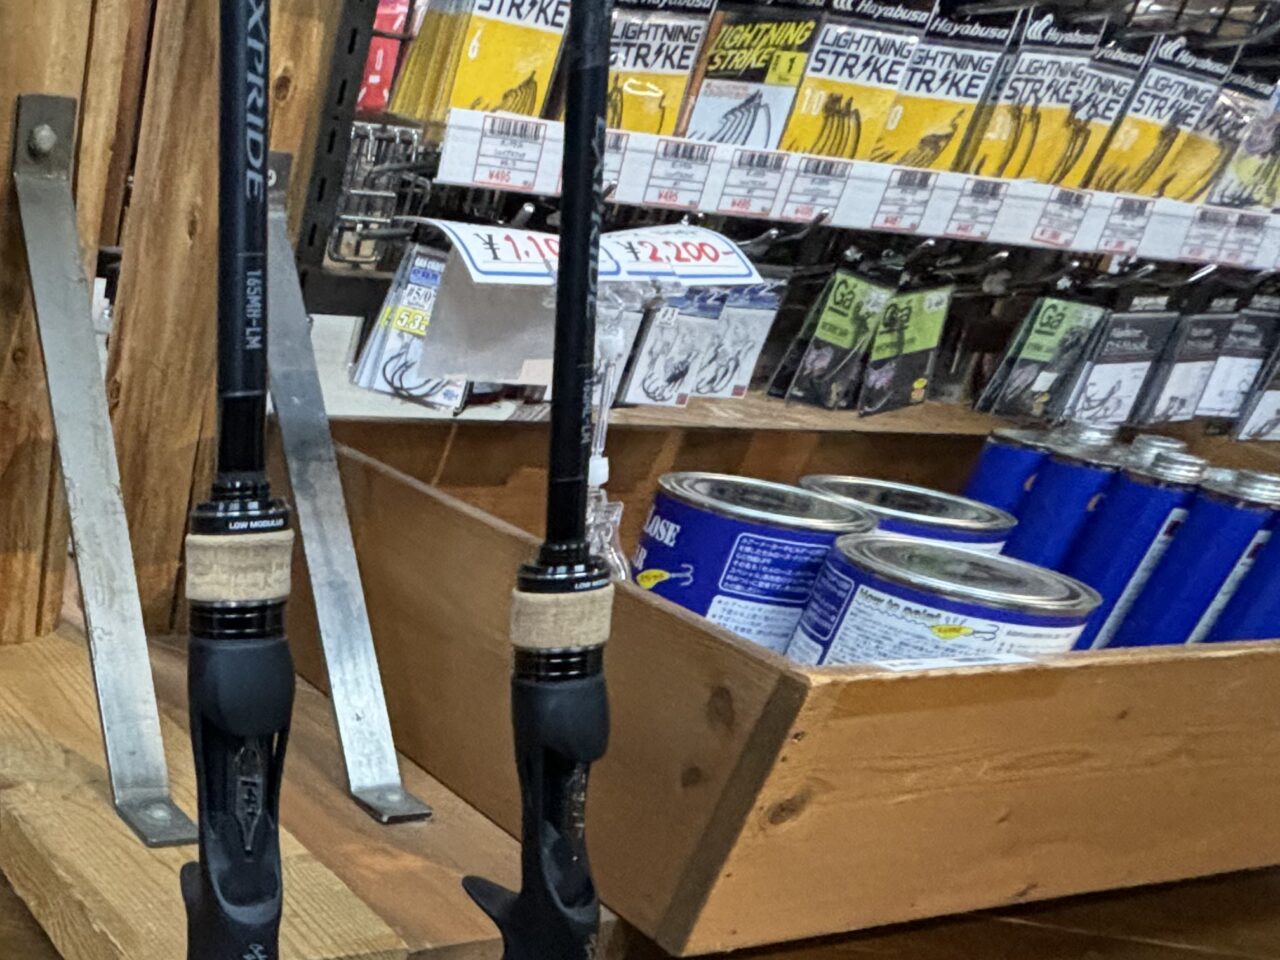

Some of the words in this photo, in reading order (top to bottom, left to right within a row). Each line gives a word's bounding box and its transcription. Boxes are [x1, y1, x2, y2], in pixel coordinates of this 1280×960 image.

[611, 22, 701, 43] LIGHTNING
[713, 20, 816, 50] LIGHTNING
[930, 17, 1010, 40] Hayabusa
[1044, 26, 1100, 45] Hayabusa
[821, 26, 914, 59] LIGHTNING
[810, 51, 905, 84] STRIKE
[911, 49, 995, 74] GHTNING
[904, 67, 986, 99] TRIKE
[228, 520, 248, 530] LOW
